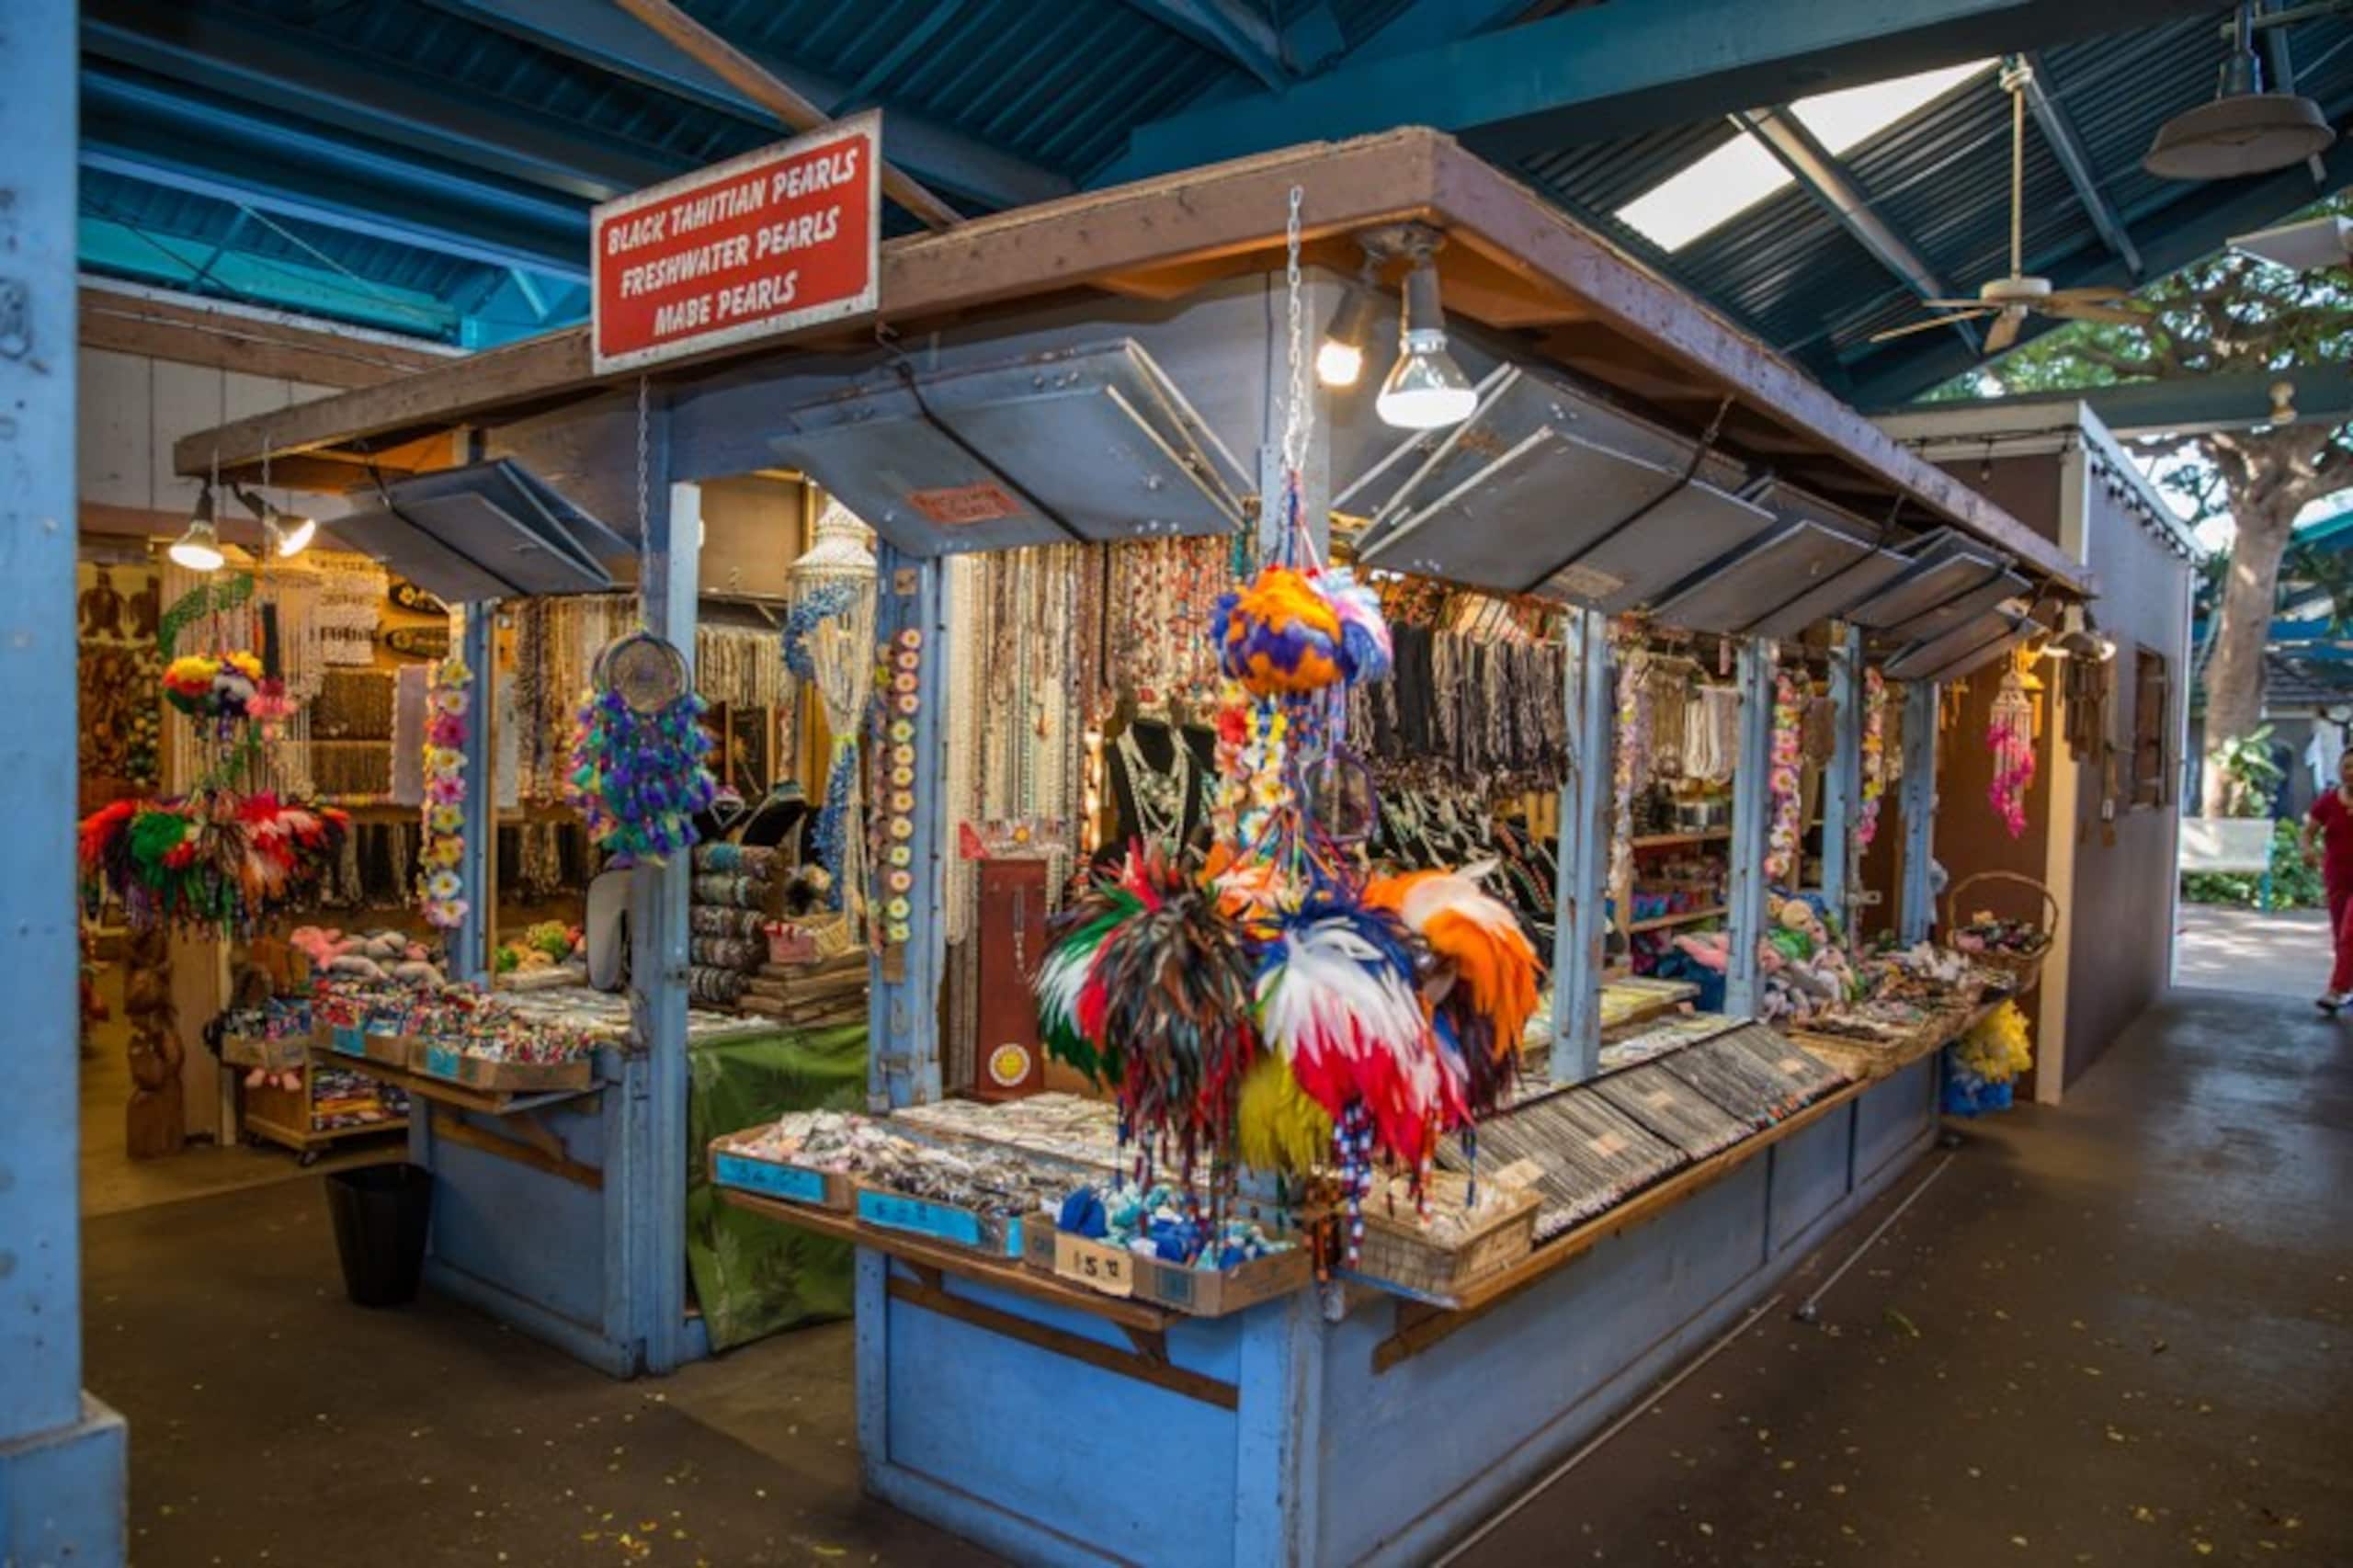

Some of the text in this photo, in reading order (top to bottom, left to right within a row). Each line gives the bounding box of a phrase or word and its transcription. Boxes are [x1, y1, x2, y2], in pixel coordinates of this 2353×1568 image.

[607, 147, 858, 256] BLACK TAHITIAN PEARLS
[620, 205, 840, 299] FRESHWATER PEARLS
[717, 270, 799, 319] PEARLS
